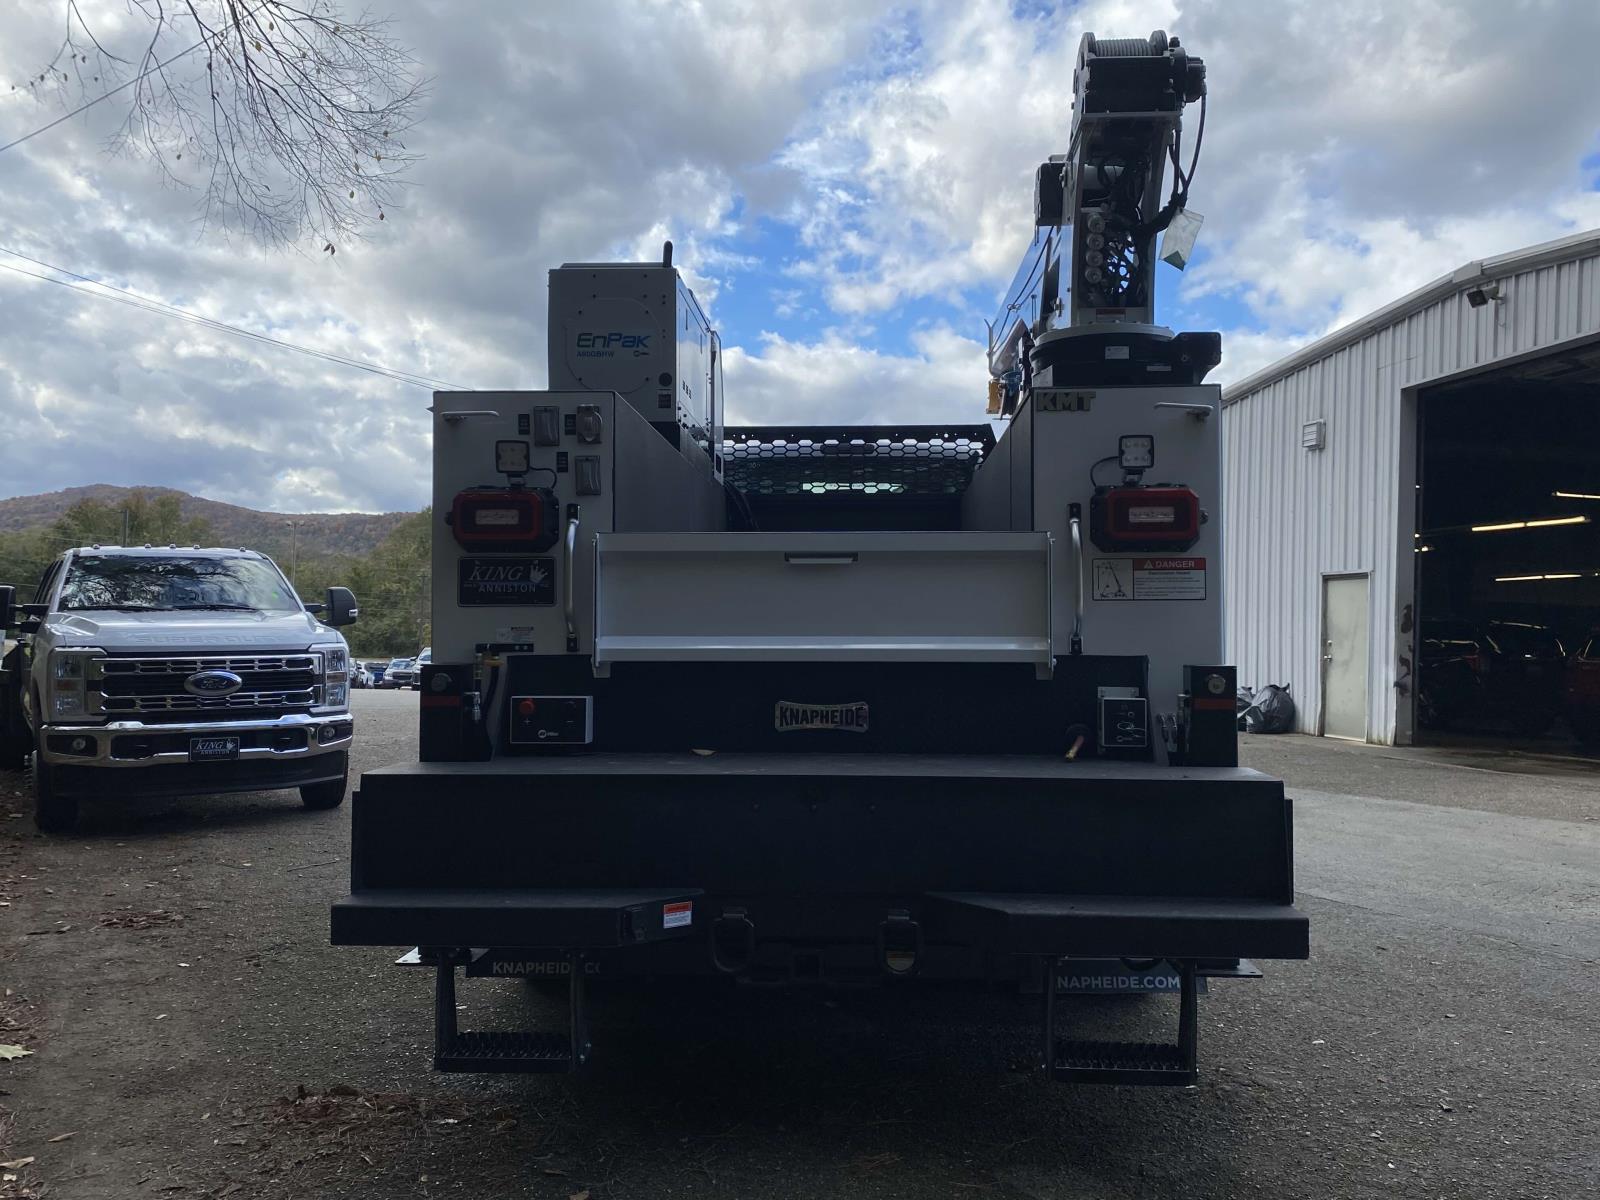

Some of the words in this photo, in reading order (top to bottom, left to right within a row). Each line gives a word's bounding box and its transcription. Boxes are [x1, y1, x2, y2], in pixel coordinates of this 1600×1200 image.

[576, 332, 651, 348] EnPak
[1037, 391, 1097, 411] KMT
[1155, 560, 1195, 568] DANGER
[469, 566, 523, 580] KING
[478, 583, 537, 593] ANNISTON
[779, 704, 867, 727] KNAPHEIDE
[196, 741, 224, 750] KING
[1057, 975, 1181, 989] NAPHEIDE.COM
